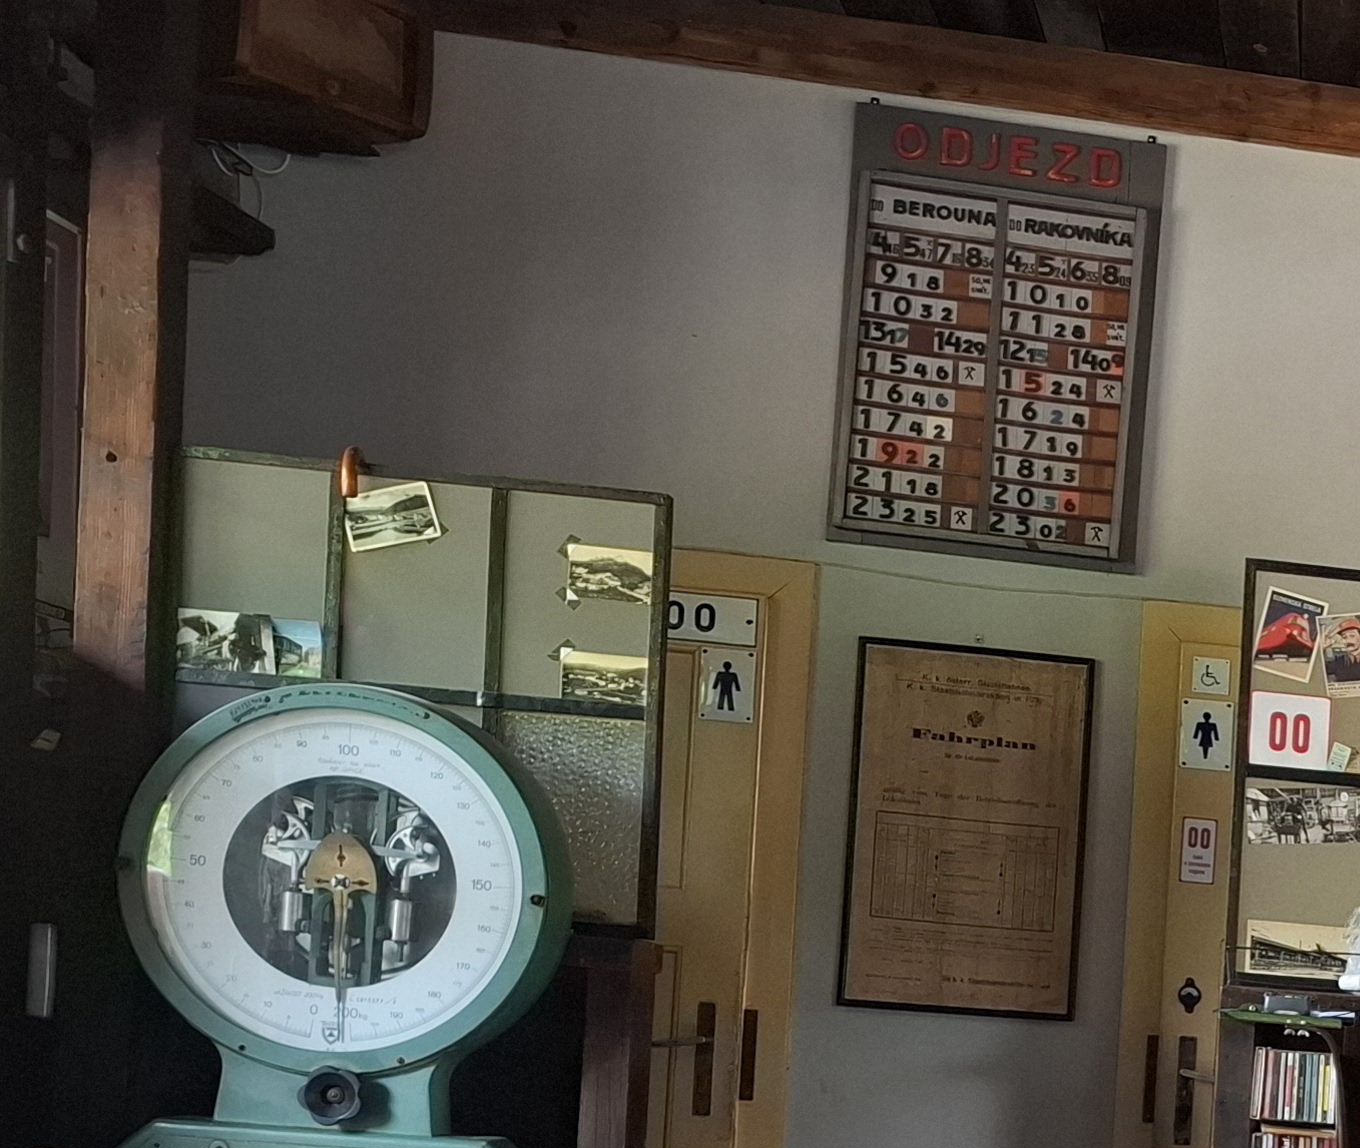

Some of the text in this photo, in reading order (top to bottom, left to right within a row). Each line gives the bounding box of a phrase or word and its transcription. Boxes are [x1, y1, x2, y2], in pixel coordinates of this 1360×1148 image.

[893, 121, 1123, 188] ODJEZD
[892, 199, 997, 228] BEROUNA
[1024, 218, 1134, 248] RAKOVNÍKA
[912, 727, 1036, 750] Fahrplan
[1269, 711, 1311, 754] 00
[338, 744, 359, 756] 100
[430, 771, 444, 779] 120
[457, 802, 470, 810] 130
[478, 840, 491, 848] 140
[1188, 826, 1211, 850] 00
[189, 854, 206, 866] 50
[472, 879, 492, 891] 150
[477, 924, 491, 932] 160
[456, 962, 470, 971] 170
[309, 1004, 318, 1015] 0
